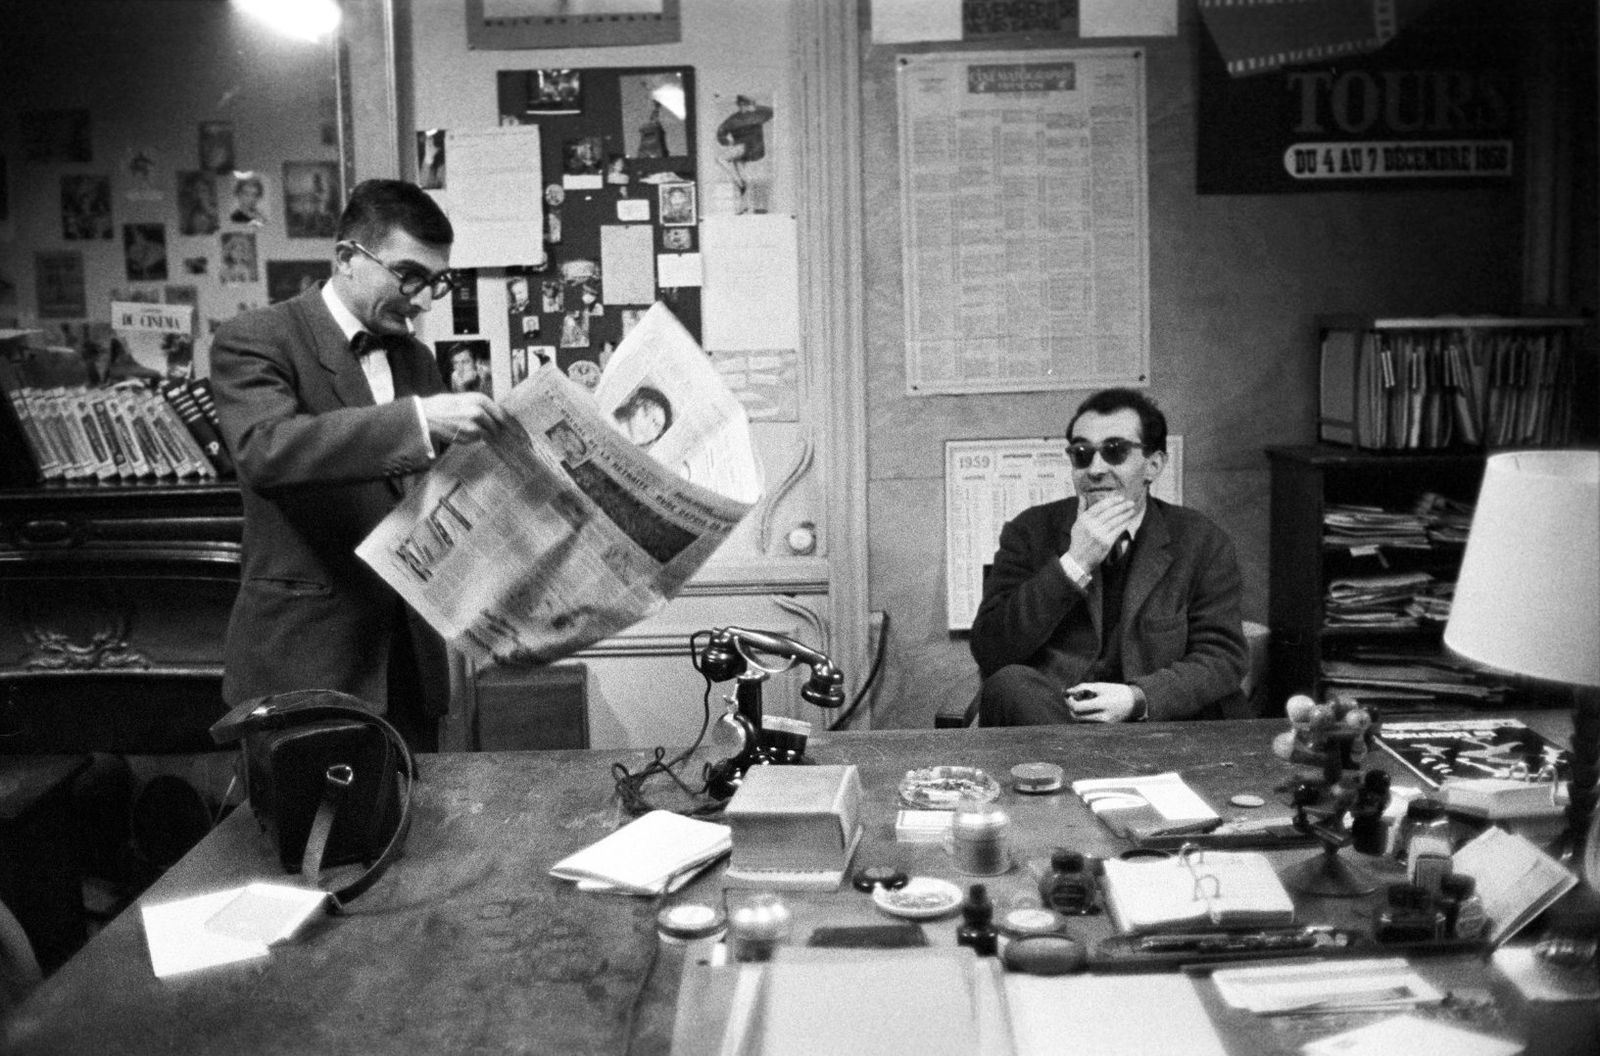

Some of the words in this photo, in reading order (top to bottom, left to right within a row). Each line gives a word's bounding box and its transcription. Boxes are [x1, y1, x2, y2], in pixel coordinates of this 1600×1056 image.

[1287, 69, 1508, 133] TOURS
[1294, 149, 1317, 173] DU
[1322, 149, 1335, 173] 4
[1340, 148, 1363, 173] AU
[1367, 147, 1378, 173] 7
[959, 455, 990, 469] 1959
